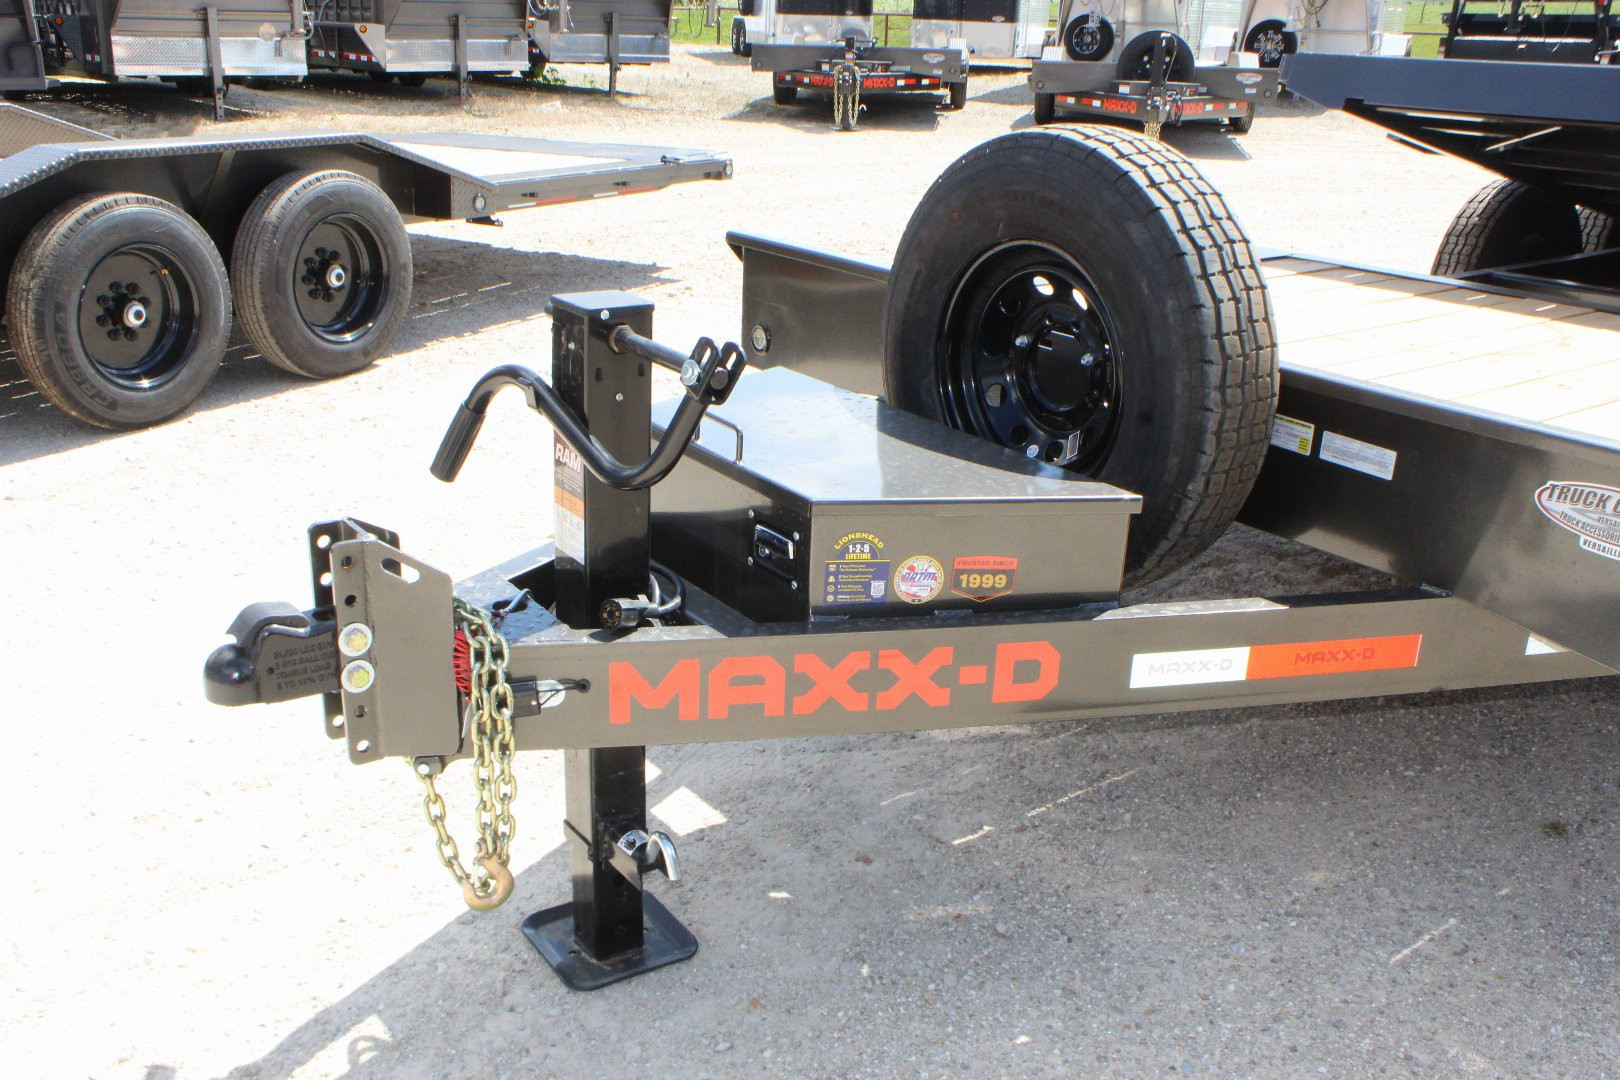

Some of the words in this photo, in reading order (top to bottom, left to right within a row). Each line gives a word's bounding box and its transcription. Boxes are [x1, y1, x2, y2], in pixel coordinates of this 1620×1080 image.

[1103, 98, 1137, 114] MAXX-D
[555, 443, 582, 473] RAM
[1546, 484, 1612, 511] TRUCK
[1559, 511, 1581, 528] TRUCK
[834, 532, 884, 550] LIONSHEAD
[959, 573, 1008, 588] 1999
[1294, 647, 1376, 665] MAXX-D
[1148, 658, 1233, 676] MAXX-D
[609, 641, 1061, 724] MAXX-D
